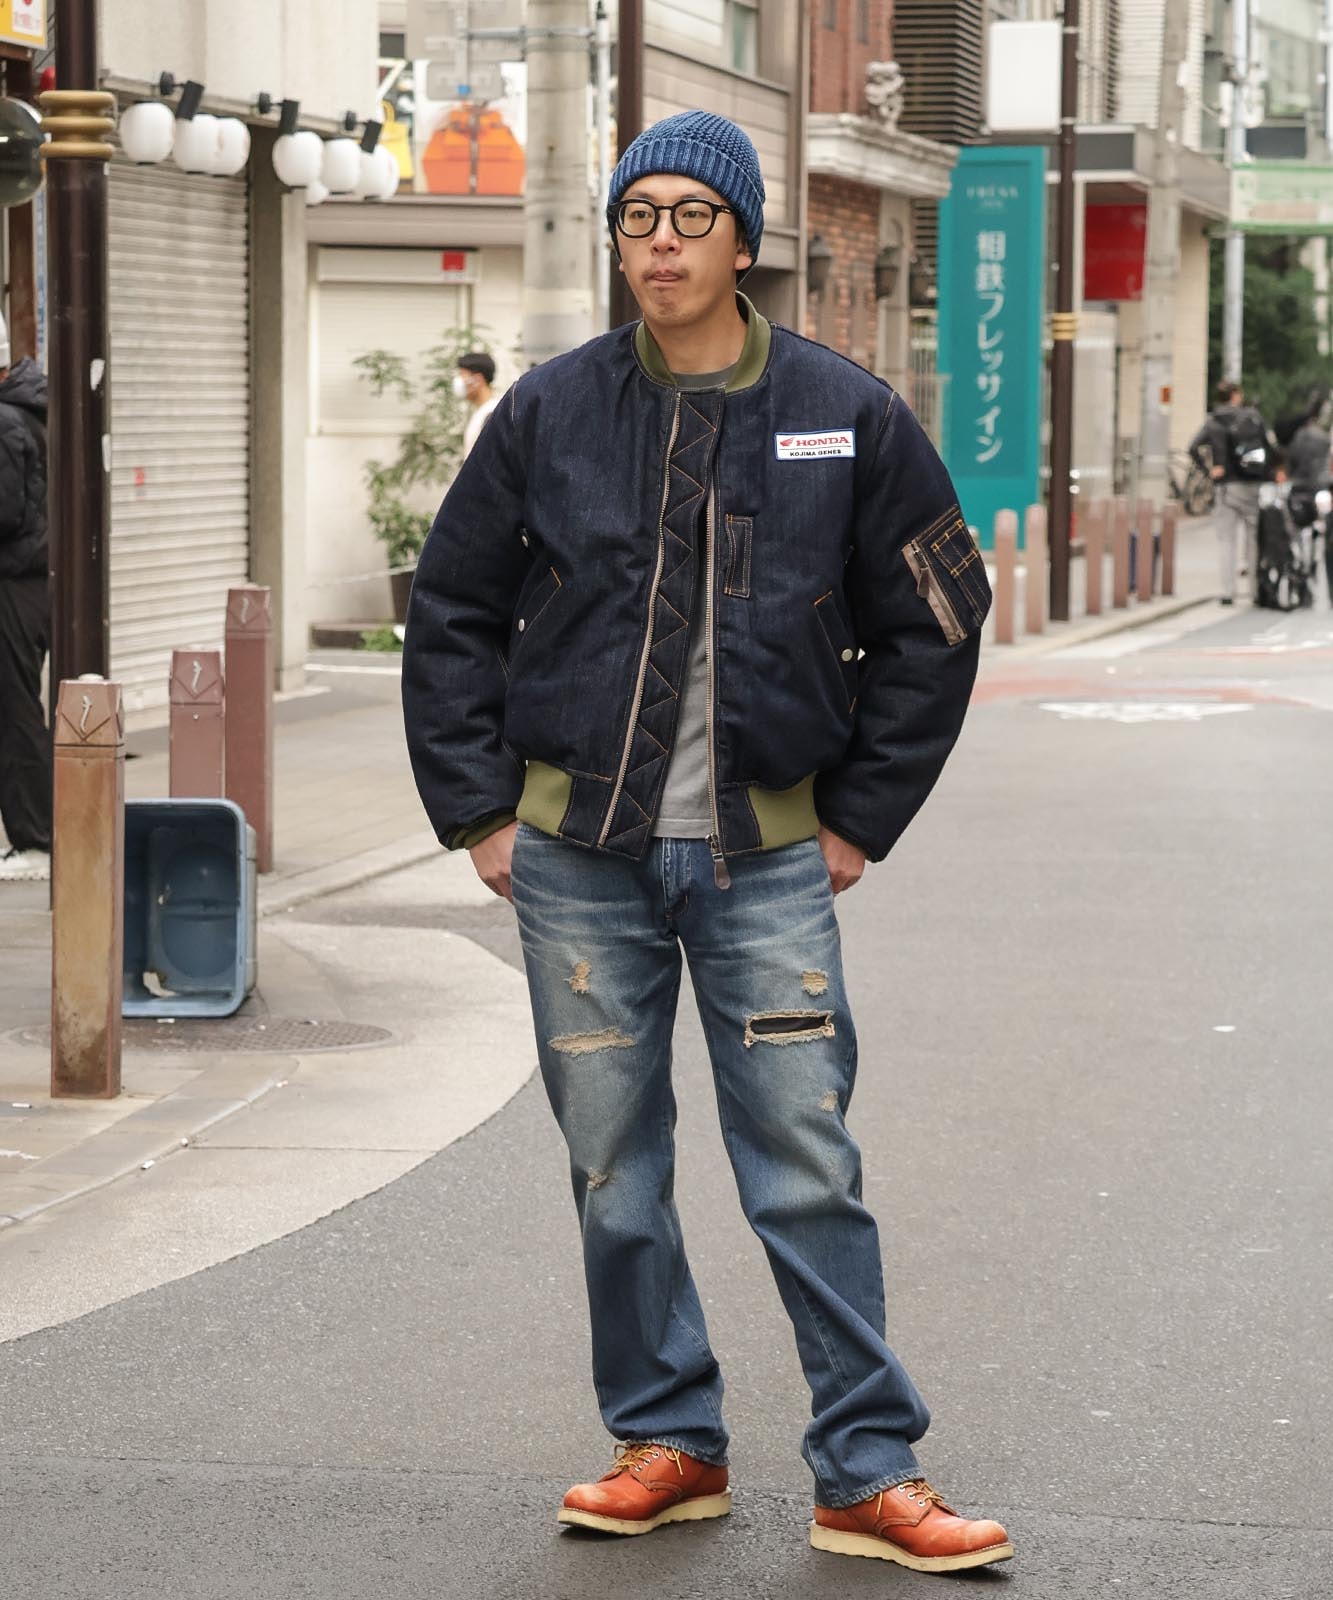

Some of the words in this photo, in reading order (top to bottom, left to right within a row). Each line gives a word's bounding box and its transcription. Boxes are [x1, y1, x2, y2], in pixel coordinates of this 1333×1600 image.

[976, 230, 1005, 463] 相鉄フレッサイン
[796, 437, 849, 446] HONDA
